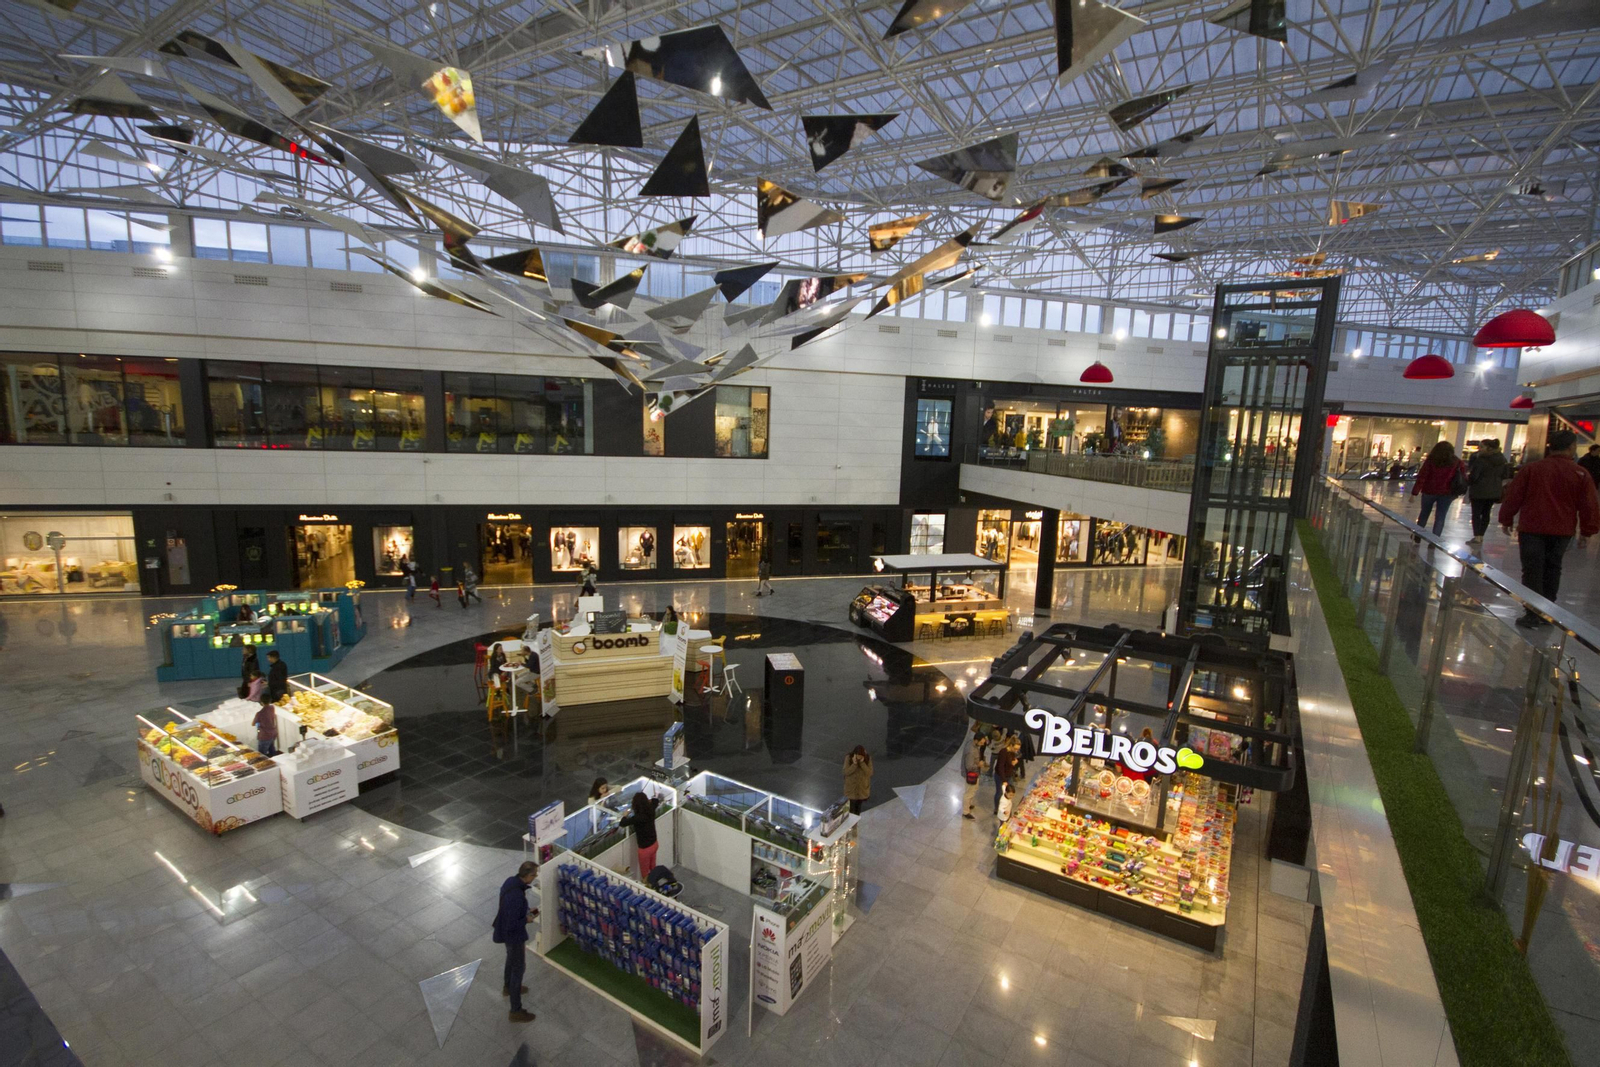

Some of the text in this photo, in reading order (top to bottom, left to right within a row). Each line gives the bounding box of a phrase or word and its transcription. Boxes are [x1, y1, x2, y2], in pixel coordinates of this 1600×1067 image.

[592, 634, 650, 650] boomb
[1024, 708, 1176, 774] BELROS
[152, 758, 199, 810] albaloo
[306, 768, 342, 786] albaloo
[226, 786, 266, 804] albaloo
[757, 942, 780, 956] NOKIA
